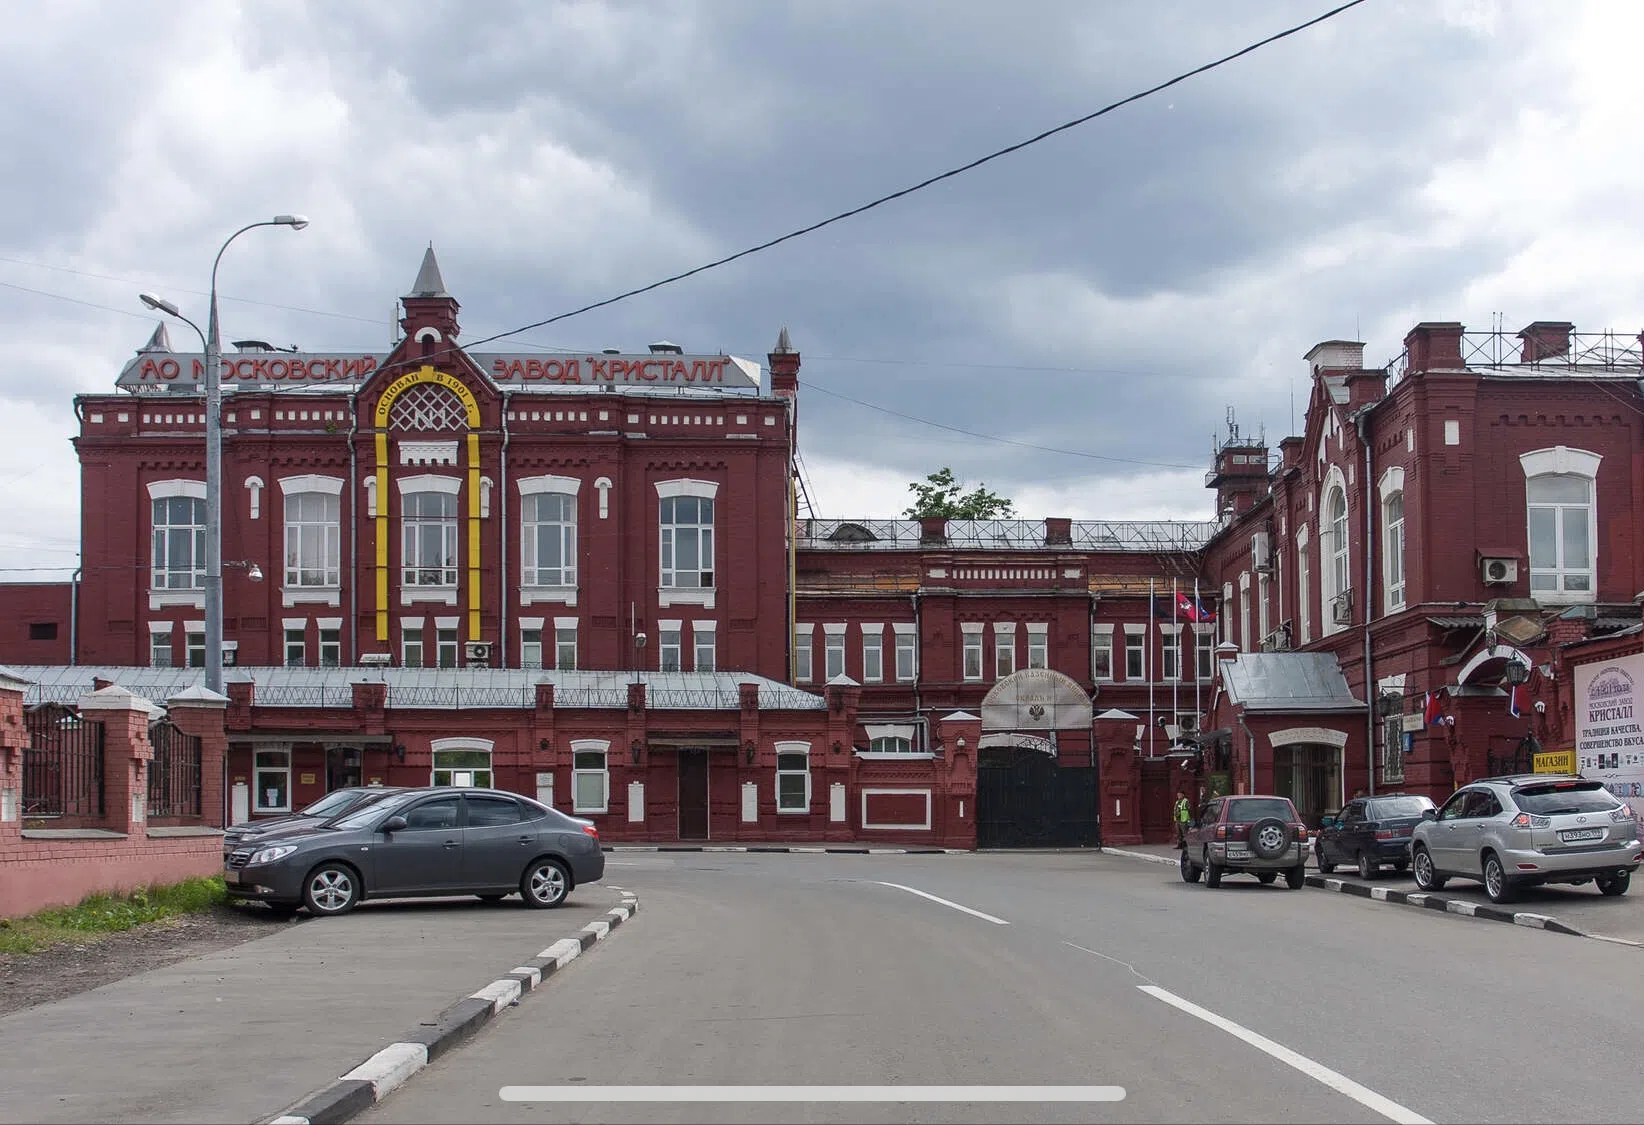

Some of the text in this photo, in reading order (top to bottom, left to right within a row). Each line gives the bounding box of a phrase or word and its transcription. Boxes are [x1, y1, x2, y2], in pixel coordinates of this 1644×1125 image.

[140, 358, 180, 380] АО
[492, 359, 581, 384] ЗАВОД
[378, 374, 419, 415] ОСНОВАН
[447, 378, 468, 399] 1901
[1589, 706, 1632, 722] КРИСТАЛЛ
[1579, 738, 1623, 751] СОВЕРШЕНСТВО
[1535, 755, 1568, 768] МАГАЗИН
